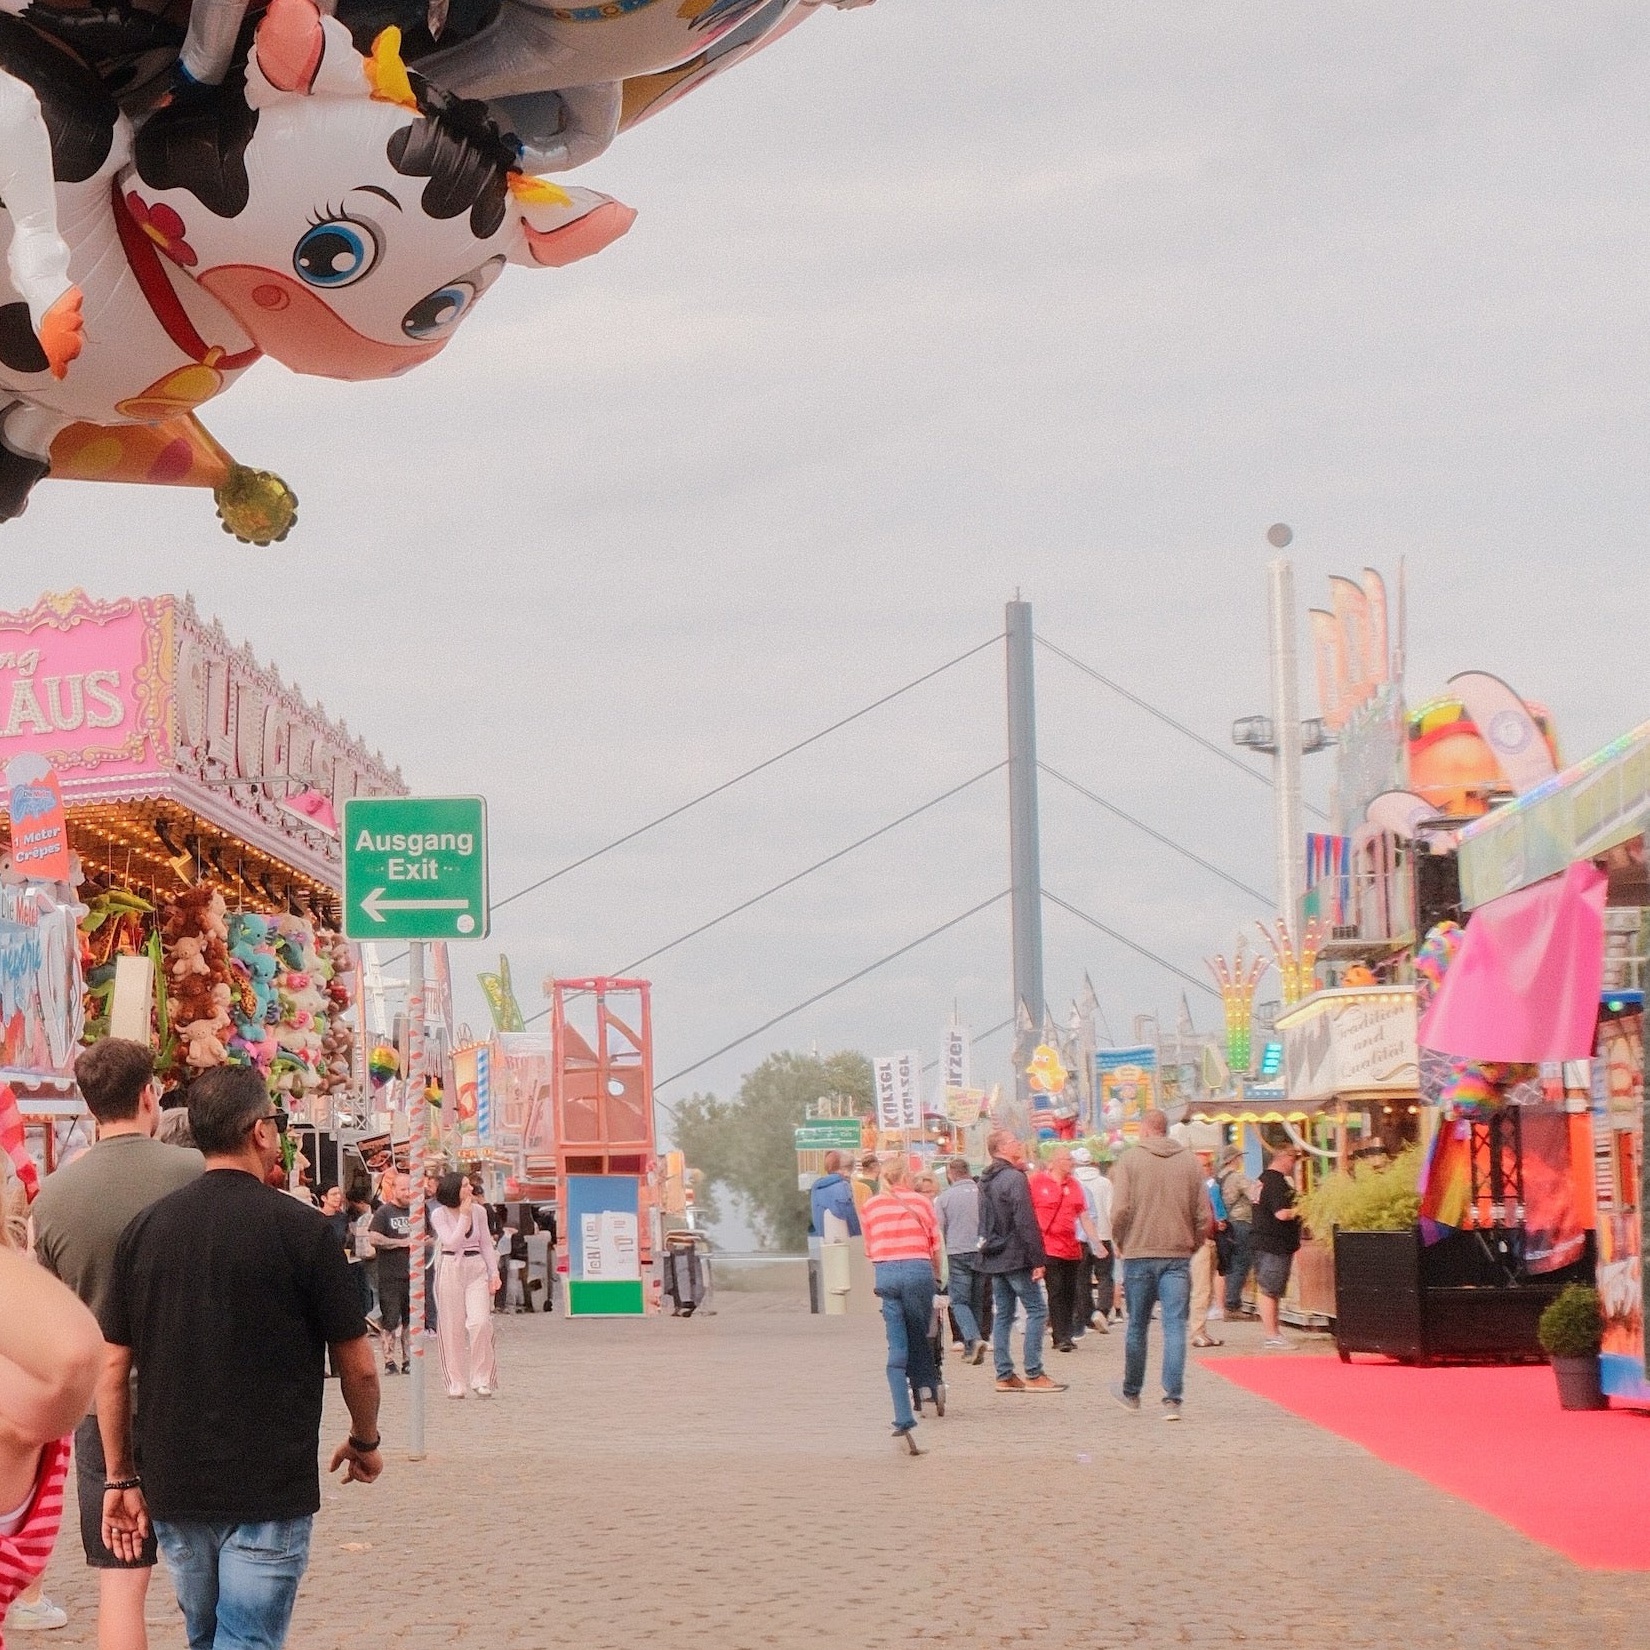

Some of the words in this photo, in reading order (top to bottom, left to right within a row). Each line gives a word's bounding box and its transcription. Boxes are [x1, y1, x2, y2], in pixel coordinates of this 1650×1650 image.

[23, 827, 62, 845] Meter
[355, 830, 473, 856] Ausgang
[15, 843, 62, 863] Crêpes
[388, 858, 438, 880] Exit
